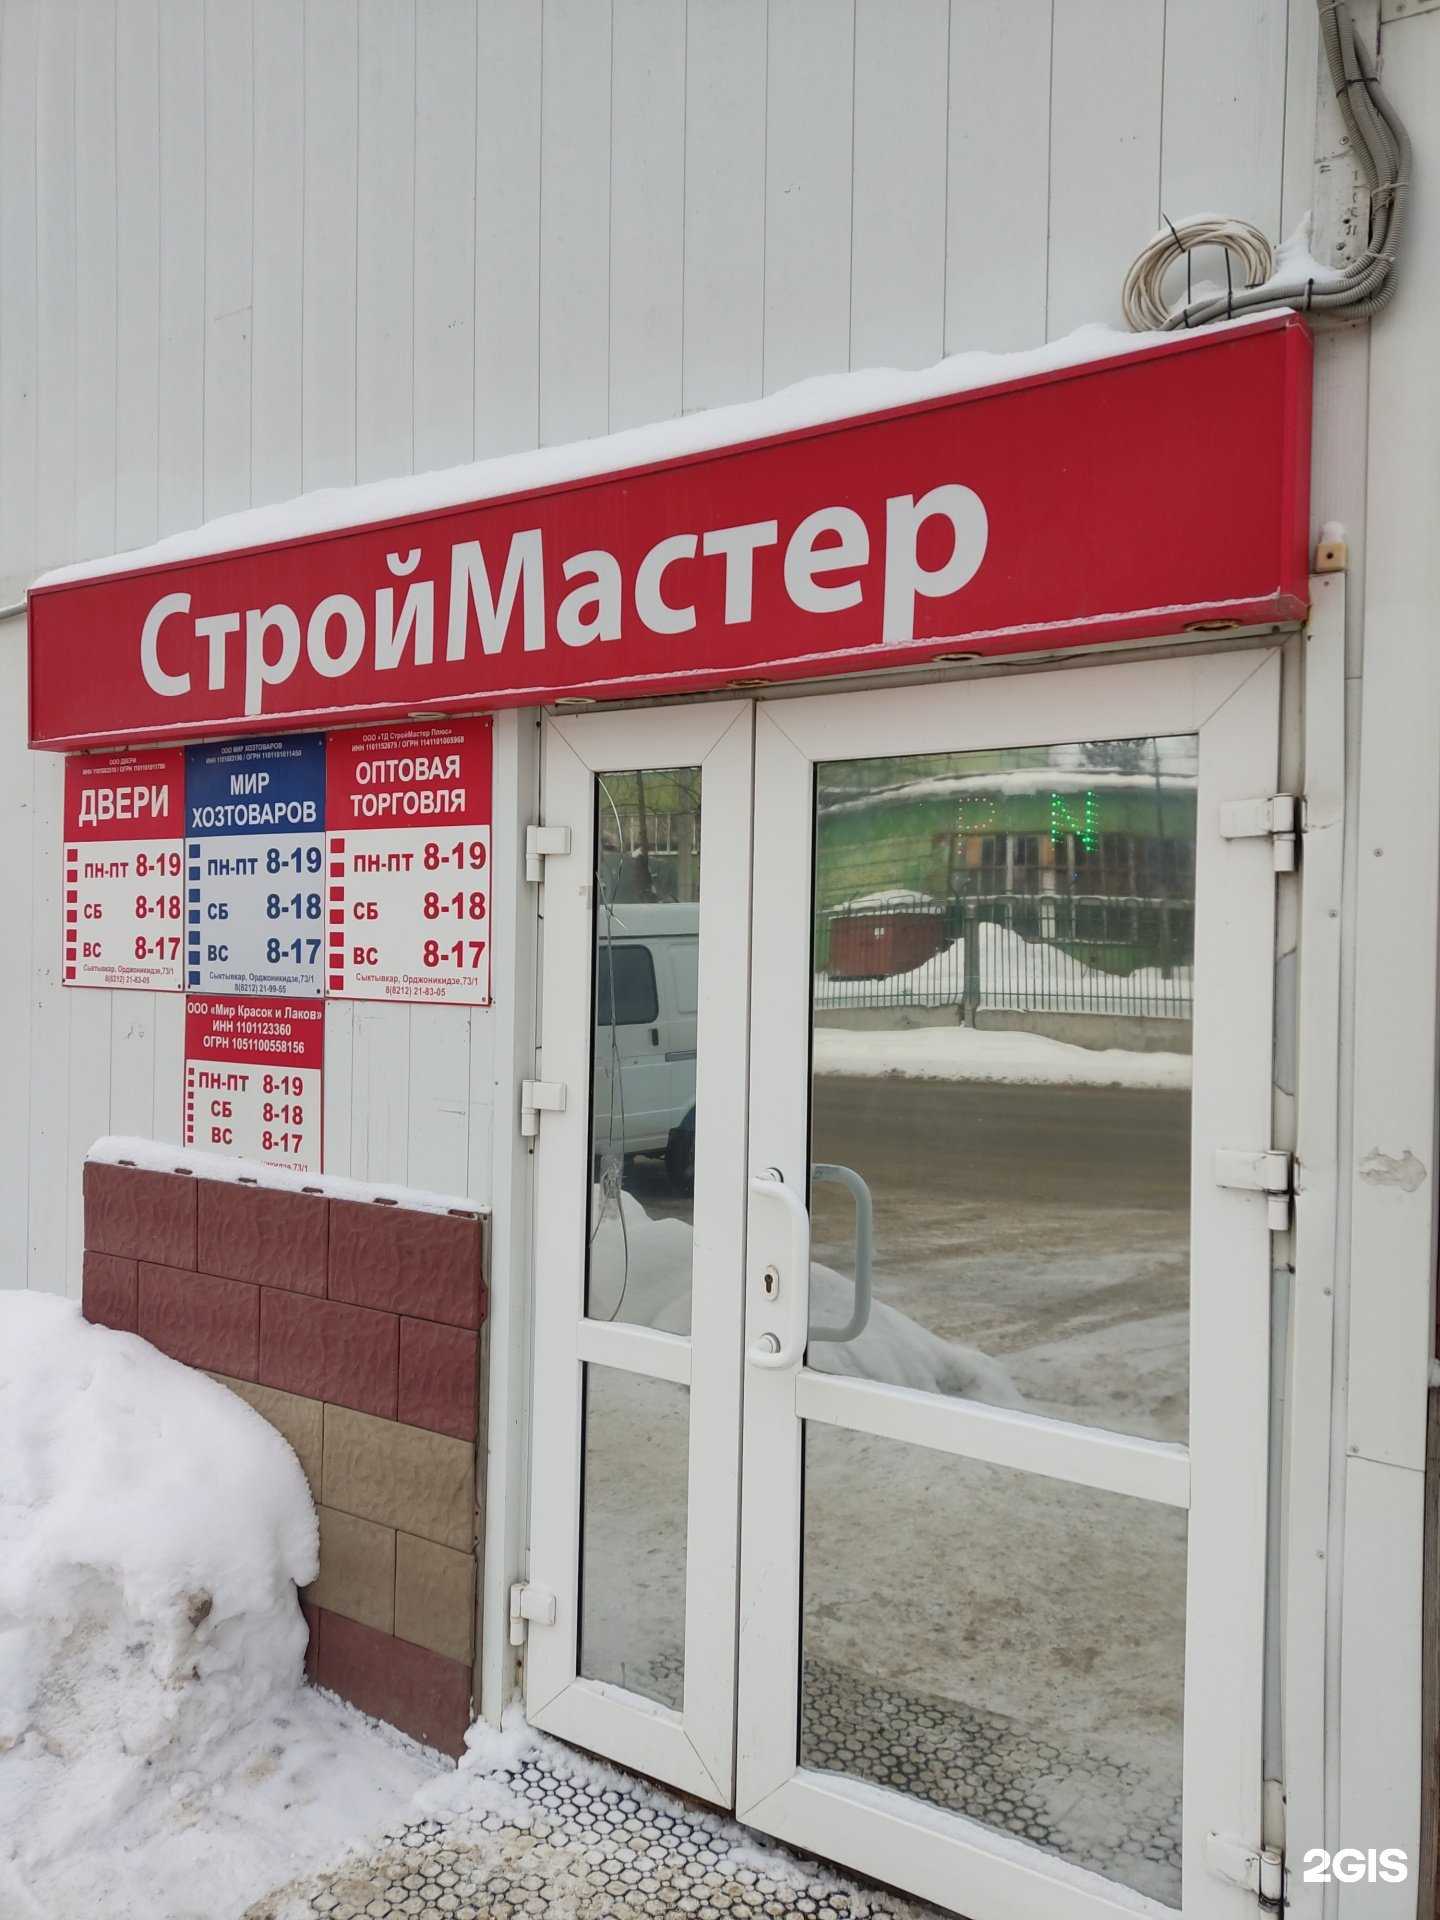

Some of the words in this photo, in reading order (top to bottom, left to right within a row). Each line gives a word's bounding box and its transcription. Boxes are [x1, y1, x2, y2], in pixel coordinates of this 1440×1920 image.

[140, 484, 988, 716] СтройМастер
[362, 734, 377, 742] ООО
[402, 739, 418, 748] ОГРН
[355, 755, 460, 784] ОПТОВАЯ
[230, 772, 270, 796] МИР
[79, 785, 168, 827] ДВЕРИ
[192, 801, 317, 828] ХОЗТОВАРОВ
[350, 788, 466, 816] ТОРГОВЛЯ
[84, 862, 129, 878] ПН-ПТ
[136, 853, 181, 877] 8-19
[208, 858, 258, 876] ПН-ПТ
[266, 847, 322, 874] 8-19
[354, 854, 413, 872] ПН-ПТ
[423, 842, 486, 870] 8-19
[84, 904, 102, 919] СБ
[135, 895, 181, 919] 8-18
[208, 903, 229, 919] СБ
[266, 893, 321, 919] 8-18
[354, 902, 378, 920] СБ
[423, 892, 486, 920] 8-18
[83, 942, 102, 958] ВС
[135, 936, 181, 960] 8-17
[207, 945, 228, 962] ВС
[266, 938, 321, 964] 8-17
[353, 947, 378, 965] ВС
[423, 940, 485, 968] 8-17
[187, 1002, 208, 1014] ООО
[210, 1003, 236, 1018] «Мир
[238, 1005, 272, 1018] Красок
[275, 1010, 282, 1018] и
[284, 1007, 322, 1020] Лаков»
[212, 1020, 233, 1032] ИНН
[236, 1021, 291, 1036] 1101123360
[203, 1036, 229, 1049] ОГРН
[232, 1038, 304, 1054] 1051100558156
[199, 1071, 249, 1092] ПН-ПТ
[263, 1074, 303, 1096] 8-19
[211, 1100, 232, 1118] СБ
[263, 1103, 303, 1125] 8-18
[211, 1127, 232, 1145] ВС
[262, 1131, 302, 1153] 8-17
